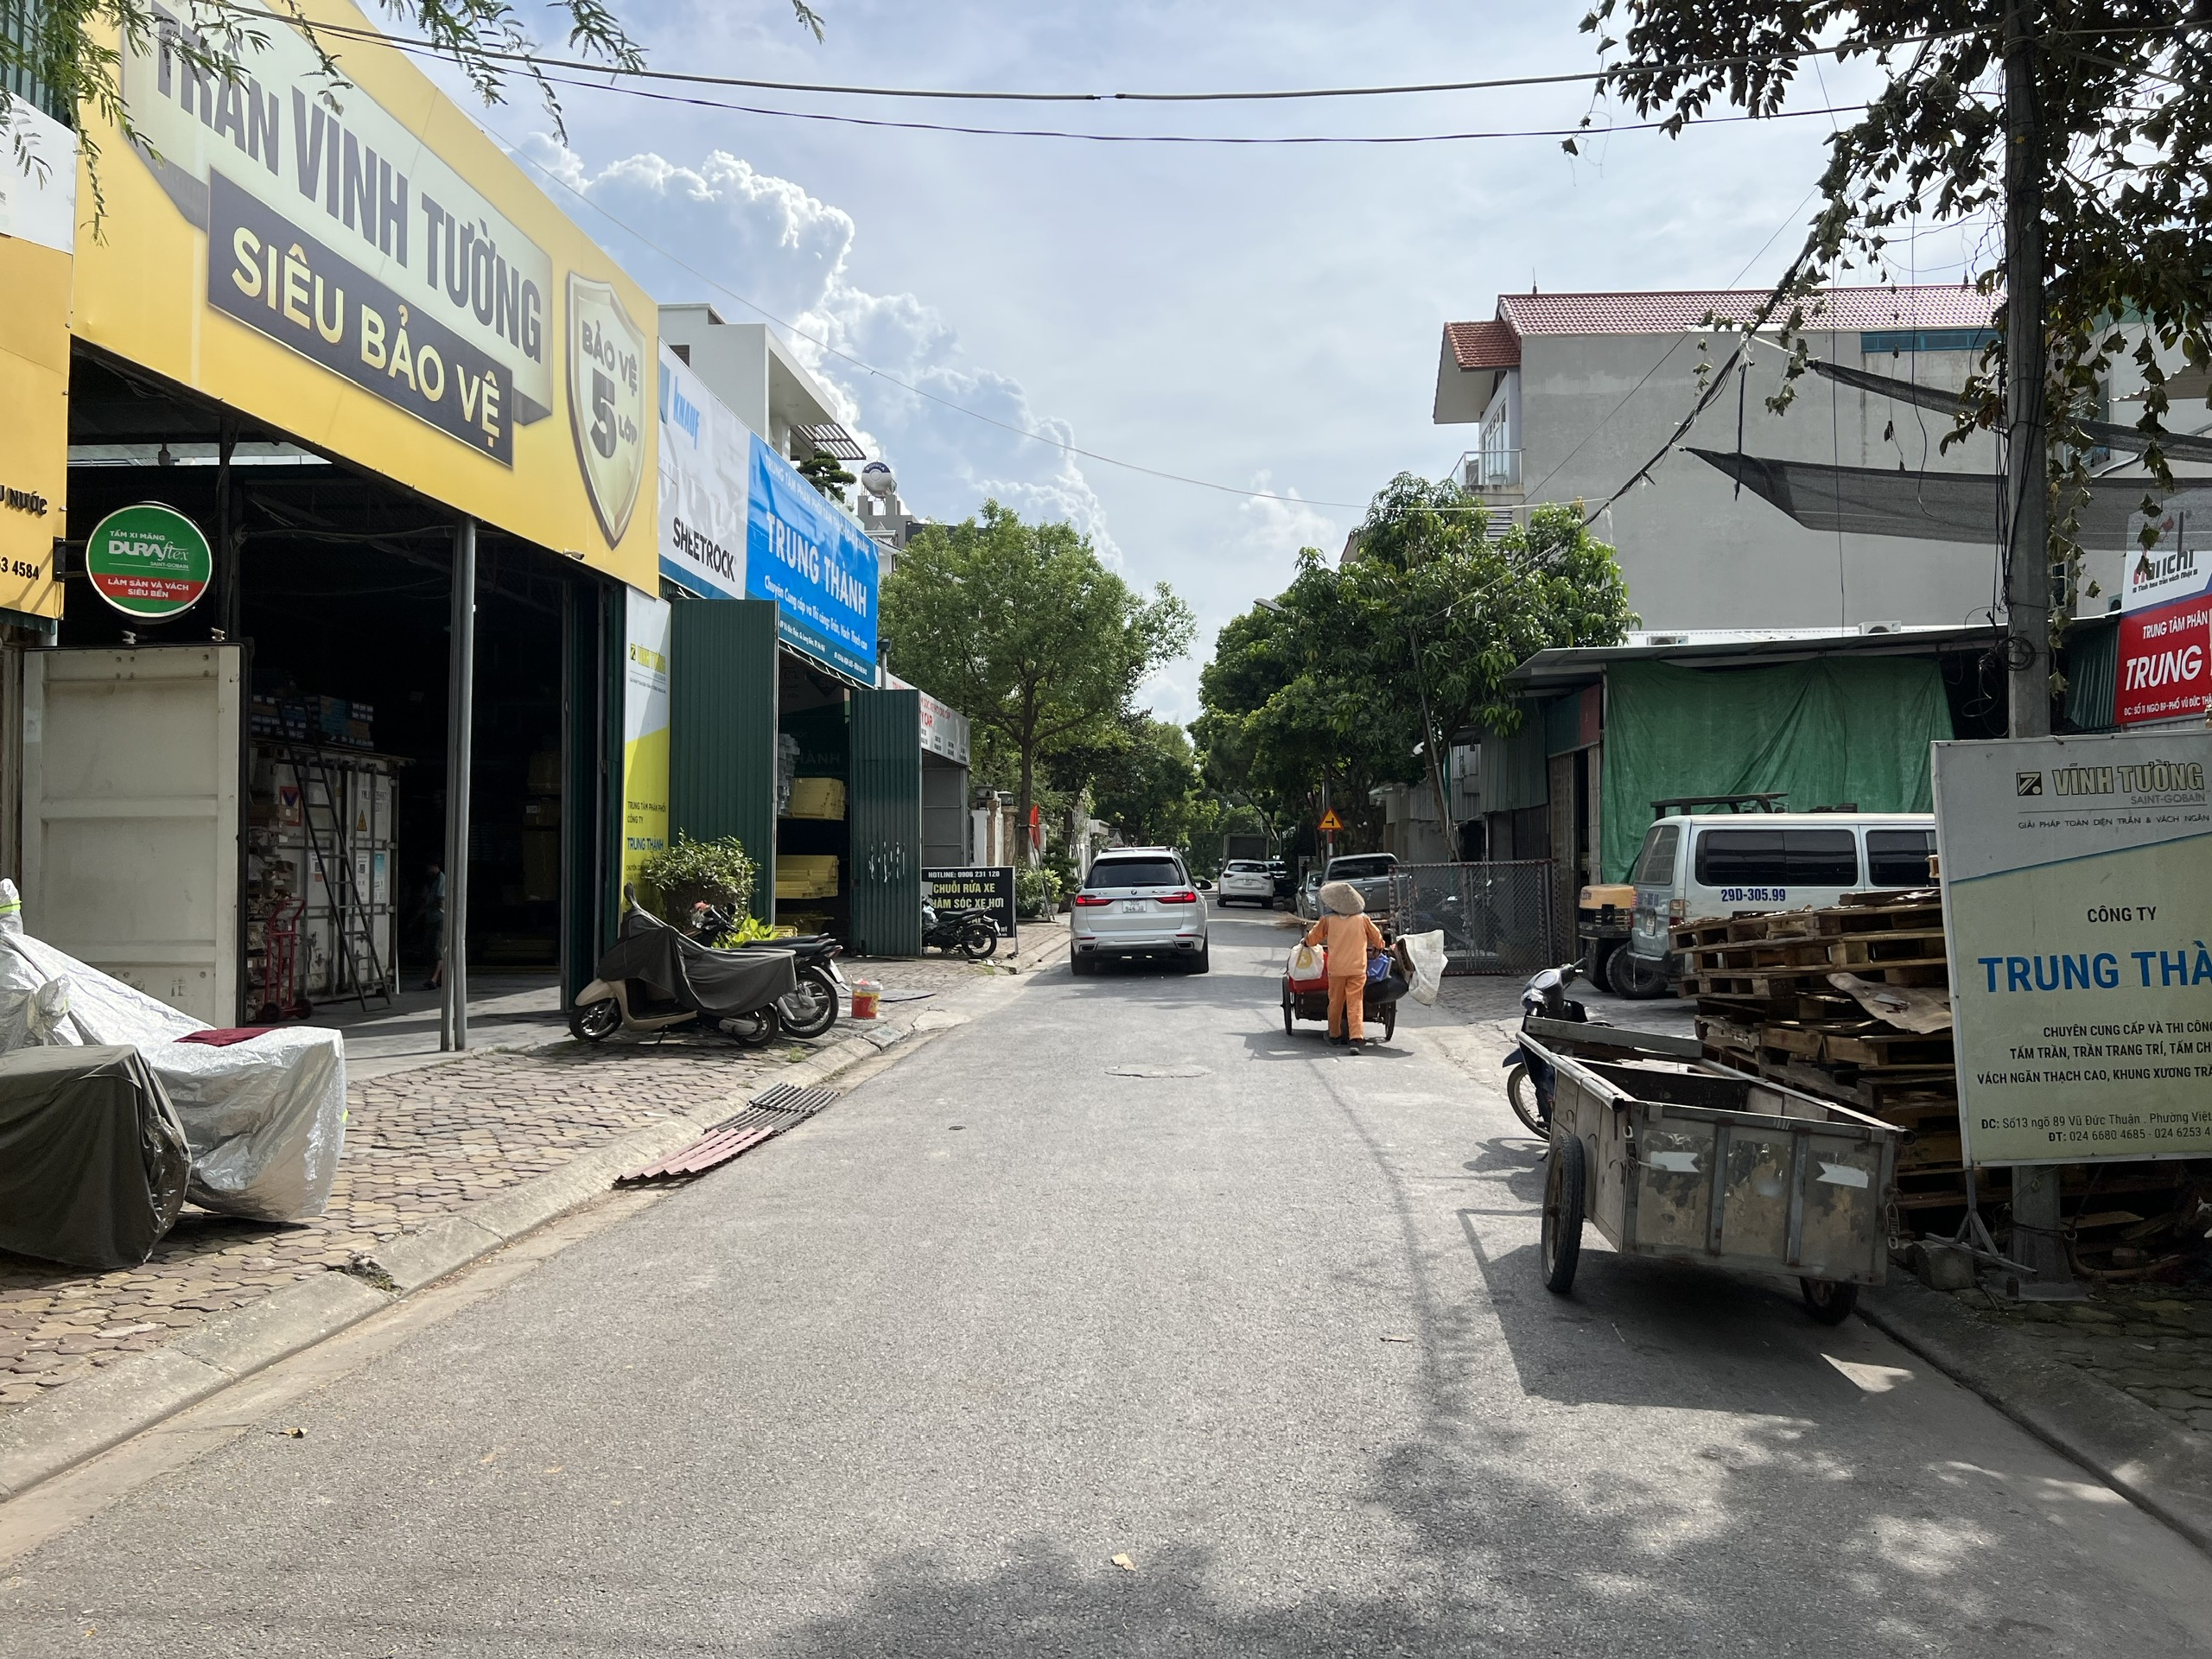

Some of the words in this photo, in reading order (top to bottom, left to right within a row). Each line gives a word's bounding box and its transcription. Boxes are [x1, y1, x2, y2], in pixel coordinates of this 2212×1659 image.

[422, 191, 541, 364] TƯỜNG
[232, 227, 344, 344] SIÊU
[361, 303, 445, 402] BẢO
[456, 364, 500, 448] VỆ
[582, 320, 615, 372] BẢO
[618, 349, 638, 397] VỆ
[590, 367, 616, 459] 5
[110, 529, 127, 538] TẤM
[140, 532, 165, 541] MĂNG
[672, 516, 736, 582] SHEETROCK
[0, 556, 8, 573] 3
[12, 560, 39, 581] 4584
[149, 561, 189, 569] SAINT-GOBAIN
[766, 511, 820, 585] TRUNG
[823, 555, 868, 618] THÀNH
[107, 577, 127, 587] LÀM
[129, 579, 149, 588] SÀN
[150, 581, 163, 589] VÀ
[165, 582, 189, 591] VÁCH
[127, 588, 149, 597] SIÊU
[150, 589, 169, 599] BỀN
[2143, 621, 2168, 640] TRUNG
[2169, 615, 2185, 634] TÂM
[2186, 609, 2209, 630] PHÂN
[2126, 645, 2202, 691] TRUNG
[2051, 762, 2114, 796] VĨNH
[2118, 759, 2204, 793] TƯỜNG
[2131, 793, 2206, 805] SAINT-GOBAIN
[2039, 819, 2061, 829] PHÁP
[2065, 818, 2089, 827] TOÀN
[2094, 817, 2113, 827] DIỆN
[2118, 815, 2142, 825] TRẦN
[2156, 815, 2180, 823] VÁCH
[626, 837, 645, 851] TRUNG
[646, 834, 664, 852] THÀNH
[933, 880, 961, 894] CHUỖI
[963, 879, 982, 893] RỬA
[983, 883, 995, 893] XE
[1721, 887, 1786, 902] 29D-305.99
[932, 897, 951, 909] HĂM
[954, 896, 972, 909] SÓC
[975, 898, 987, 908] XE
[988, 897, 1004, 908] HƠI
[2088, 906, 2133, 923] CÔNG
[2136, 906, 2157, 921] TY
[1978, 952, 2120, 993] TRUNG
[2044, 1024, 2087, 1038] CHUYÊN
[2090, 1025, 2120, 1036] CUNG
[2123, 1021, 2145, 1034] CẤP
[2148, 1020, 2163, 1034] VÀ
[2165, 1022, 2183, 1033] THI
[2010, 1046, 2034, 1059] TẤM
[2037, 1045, 2070, 1059] TRẦN,
[2073, 1043, 2102, 1058] TRẦN
[2106, 1044, 2143, 1056] TRANG
[2145, 1040, 2166, 1057] TRÍ,
[2169, 1039, 2193, 1054] TẤM
[2196, 1042, 2212, 1053] CH
[1978, 1071, 2007, 1084] VÁCH
[2011, 1070, 2040, 1083] NGĂN
[2044, 1070, 2081, 1084] THẠCH
[2084, 1070, 2111, 1082] CAO,
[2113, 1068, 2151, 1080] KHUNG
[2153, 1066, 2191, 1078] XƯƠNG
[1981, 1119, 1999, 1129] ĐC:
[2031, 1116, 2050, 1129] ngõ
[2053, 1116, 2065, 1127] 89
[2069, 1114, 2082, 1126] Vũ
[2085, 1114, 2106, 1126] Đức
[2109, 1112, 2140, 1126] Thuận
[2150, 1111, 2189, 1125] Phường
[2191, 1111, 2212, 1122] Việt
[2049, 1132, 2067, 1141] ĐT:
[2069, 1131, 2088, 1141] 024
[2092, 1130, 2117, 1140] 6680
[2120, 1129, 2145, 1139] 4685
[2154, 1128, 2173, 1138] 024
[2177, 1127, 2201, 1137] 6253
